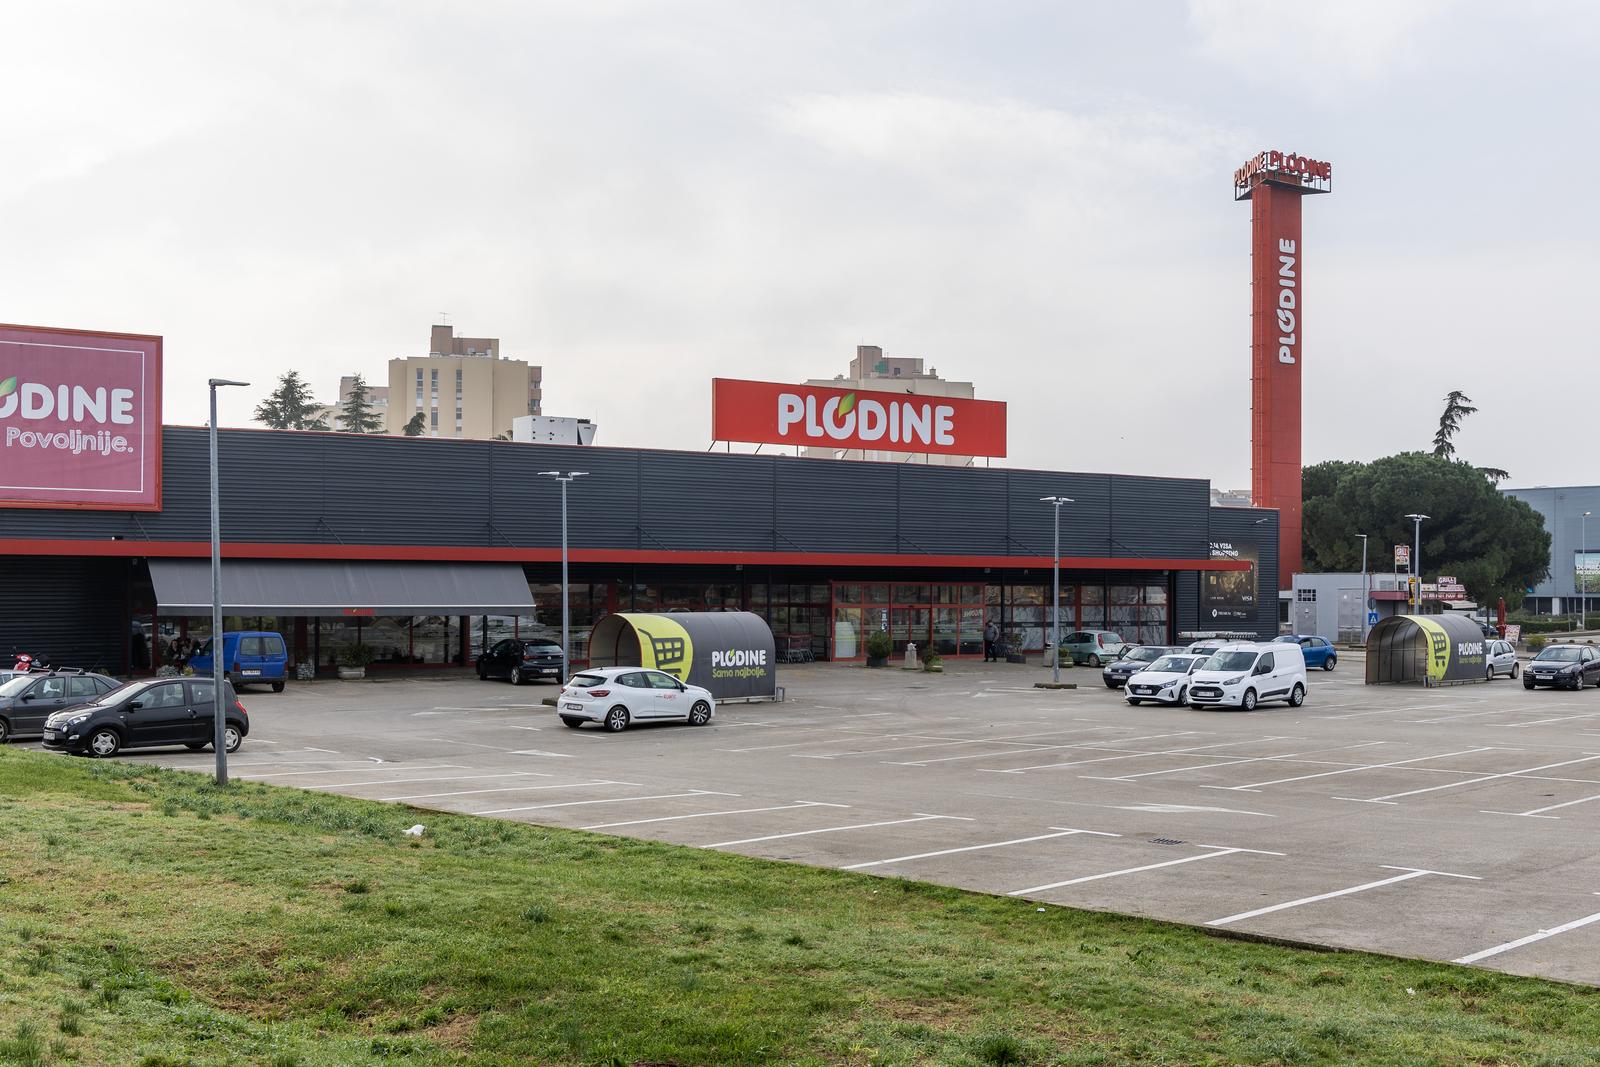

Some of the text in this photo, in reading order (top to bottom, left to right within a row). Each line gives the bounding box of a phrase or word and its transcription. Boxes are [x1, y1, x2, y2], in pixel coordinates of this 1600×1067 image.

[1234, 151, 1265, 184] PLODINE
[1270, 150, 1331, 180] PLODINE
[1276, 238, 1295, 364] PLODINE
[778, 394, 954, 445] PLODINE
[6, 426, 134, 456] Povoljnije.
[712, 648, 766, 667] PLODINE
[1459, 642, 1482, 655] PLODINE
[712, 668, 734, 679] Samo
